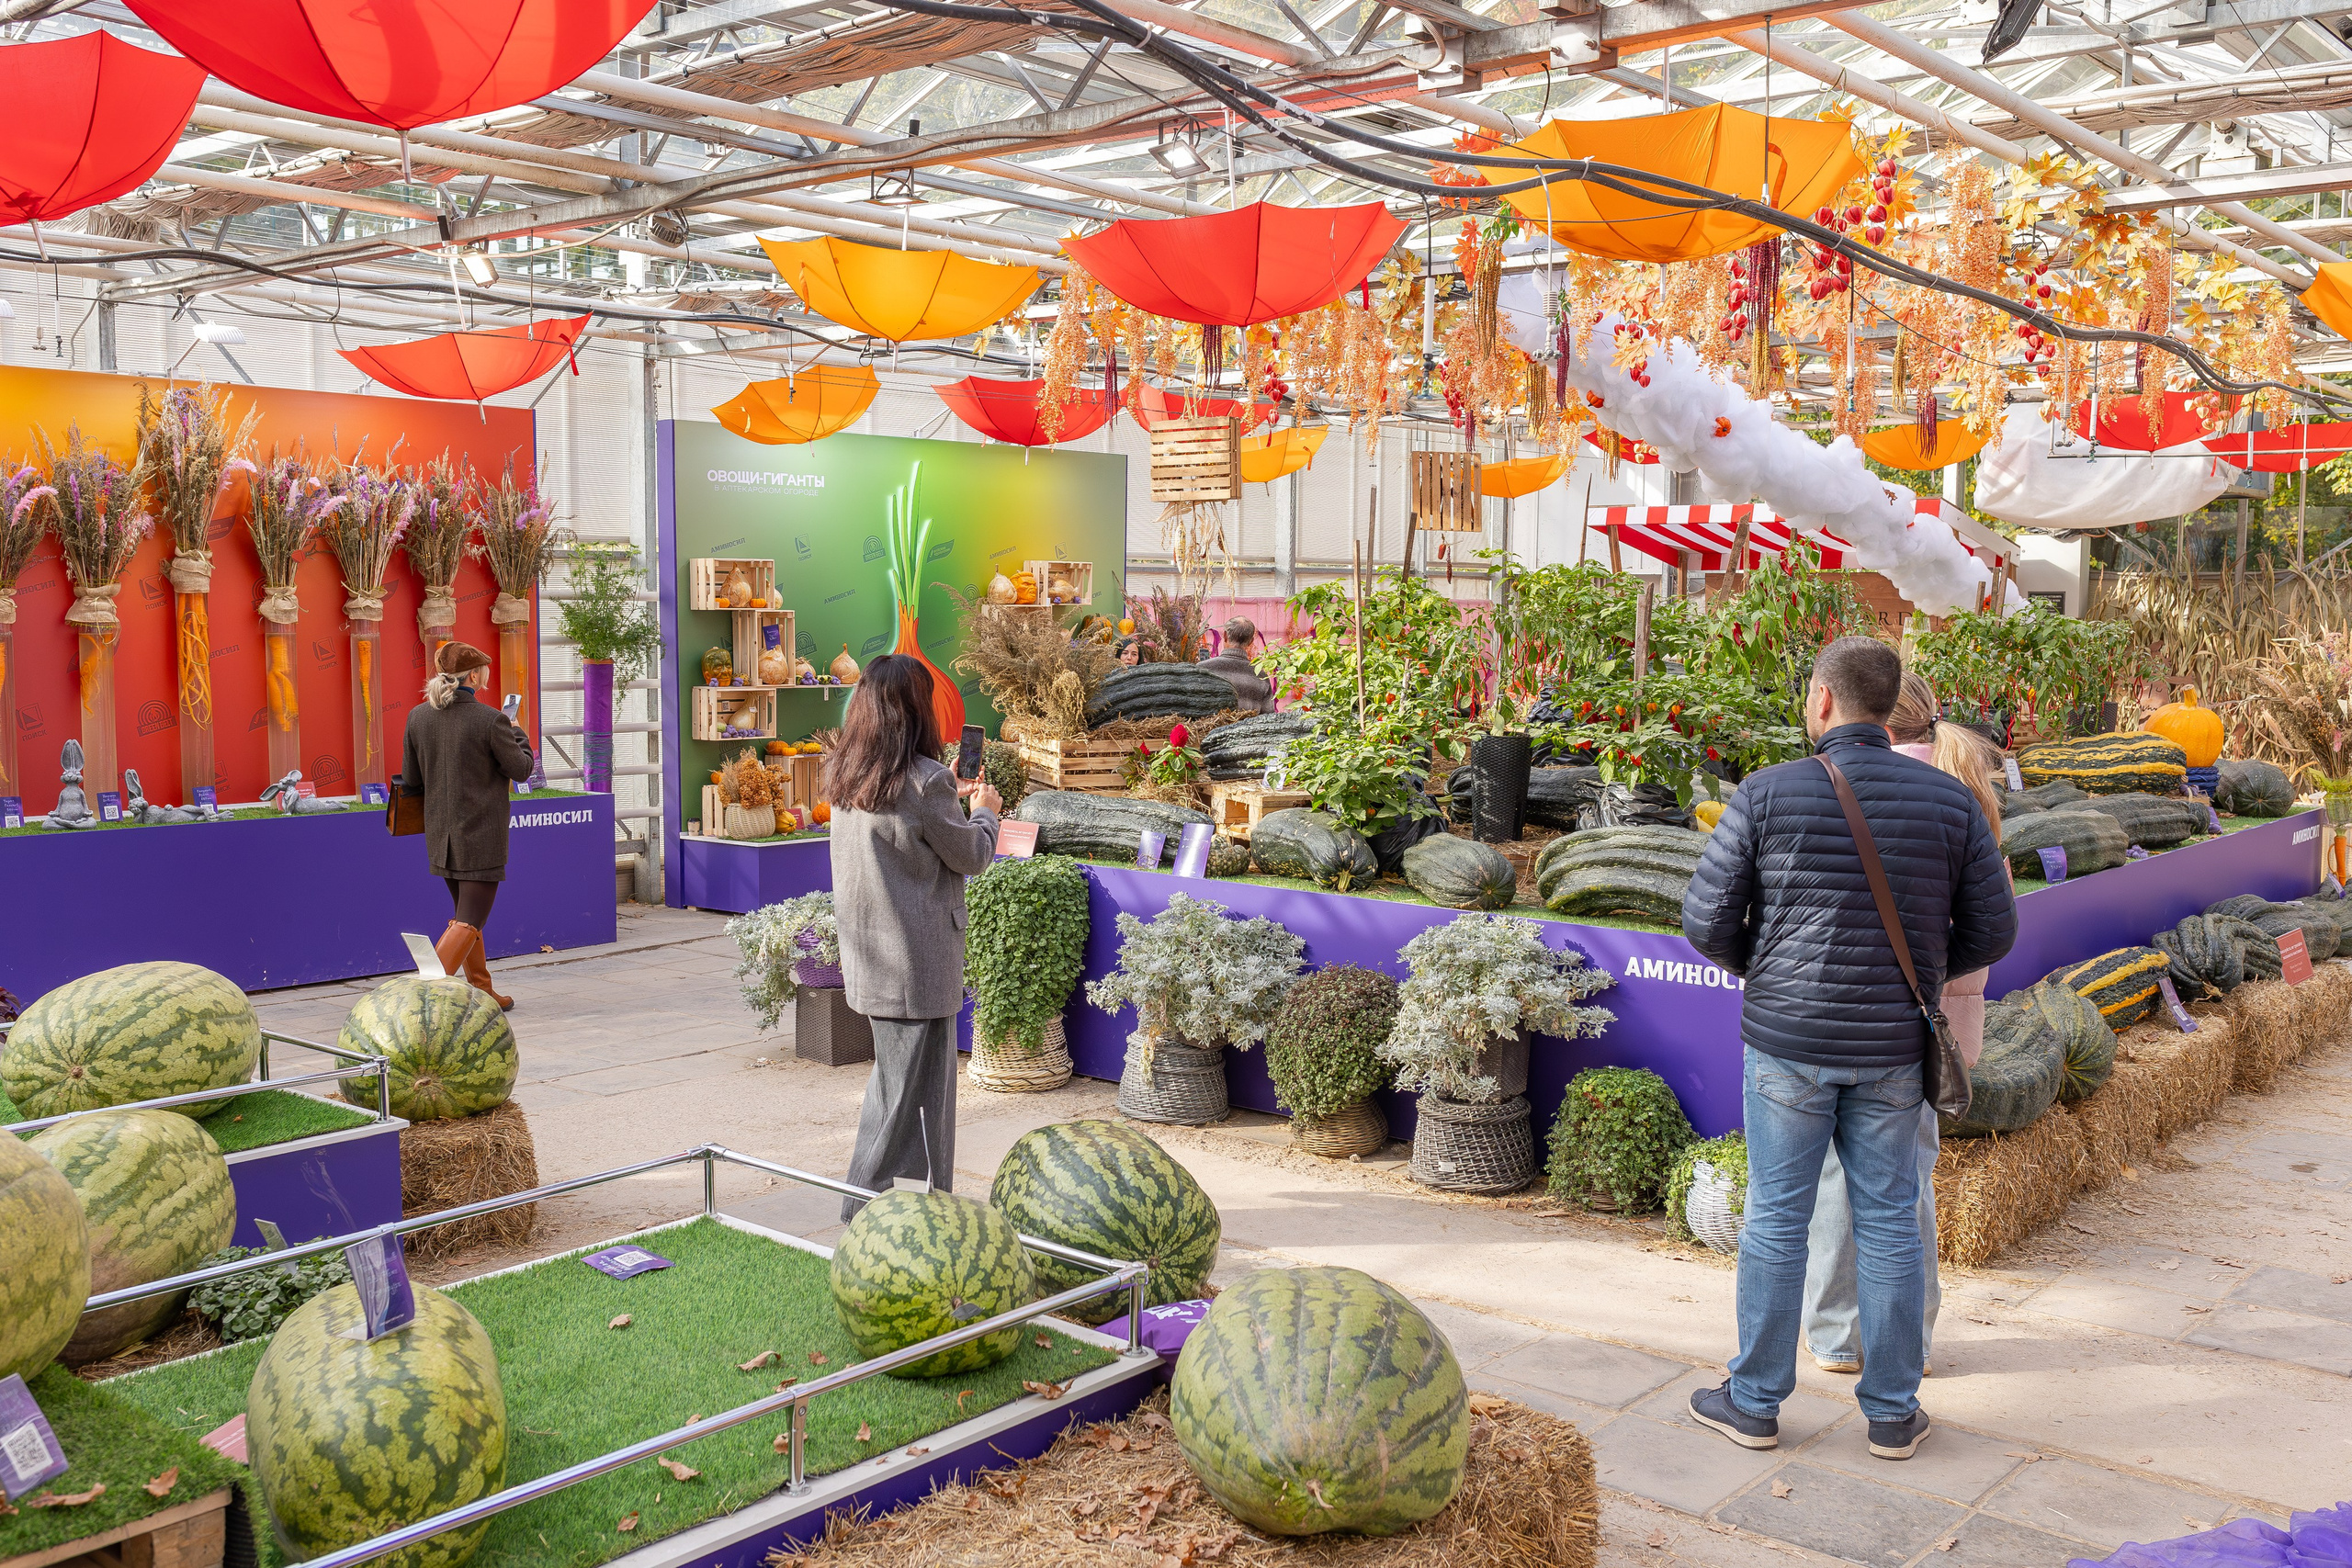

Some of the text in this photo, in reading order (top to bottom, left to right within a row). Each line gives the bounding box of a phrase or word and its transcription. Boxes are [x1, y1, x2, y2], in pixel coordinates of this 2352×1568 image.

[707, 469, 825, 488] ОВОЩИ-ГИГАНТЫ
[722, 484, 781, 495] АПТЕКАРСКОМ
[784, 488, 819, 497] ОГОРОДЕ
[710, 537, 746, 554] АМИНОСИЛ
[141, 717, 173, 734] GREEN BELT
[22, 729, 47, 741] ПОИСК
[509, 809, 593, 829] АМИНОСИЛ
